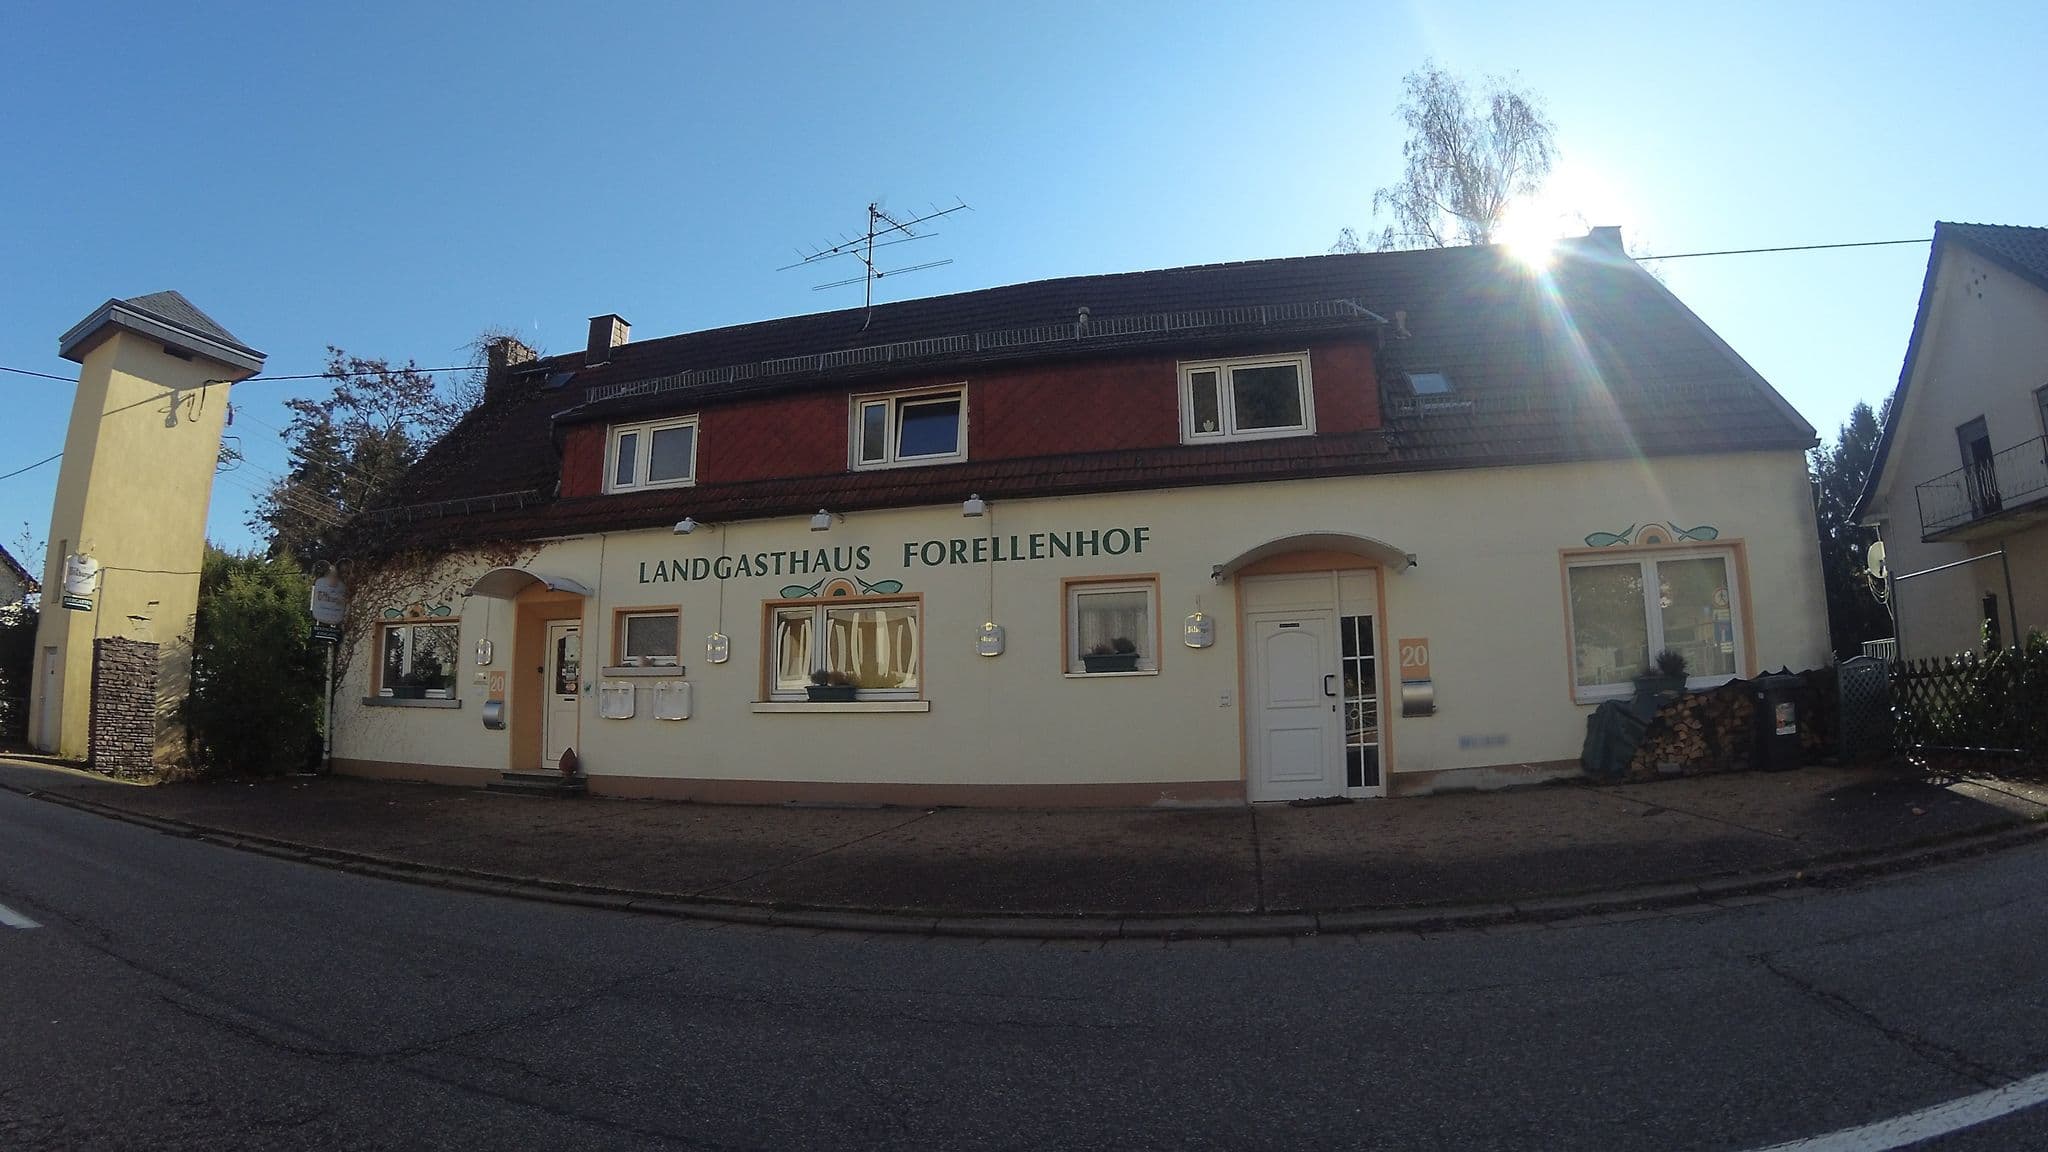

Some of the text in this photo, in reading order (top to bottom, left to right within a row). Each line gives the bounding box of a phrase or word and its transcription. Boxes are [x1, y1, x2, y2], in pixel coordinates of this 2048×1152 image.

[639, 527, 1150, 584] LANDGASTHAUS FORELLENHOF
[1402, 645, 1428, 667] 20
[490, 676, 504, 692] 20
